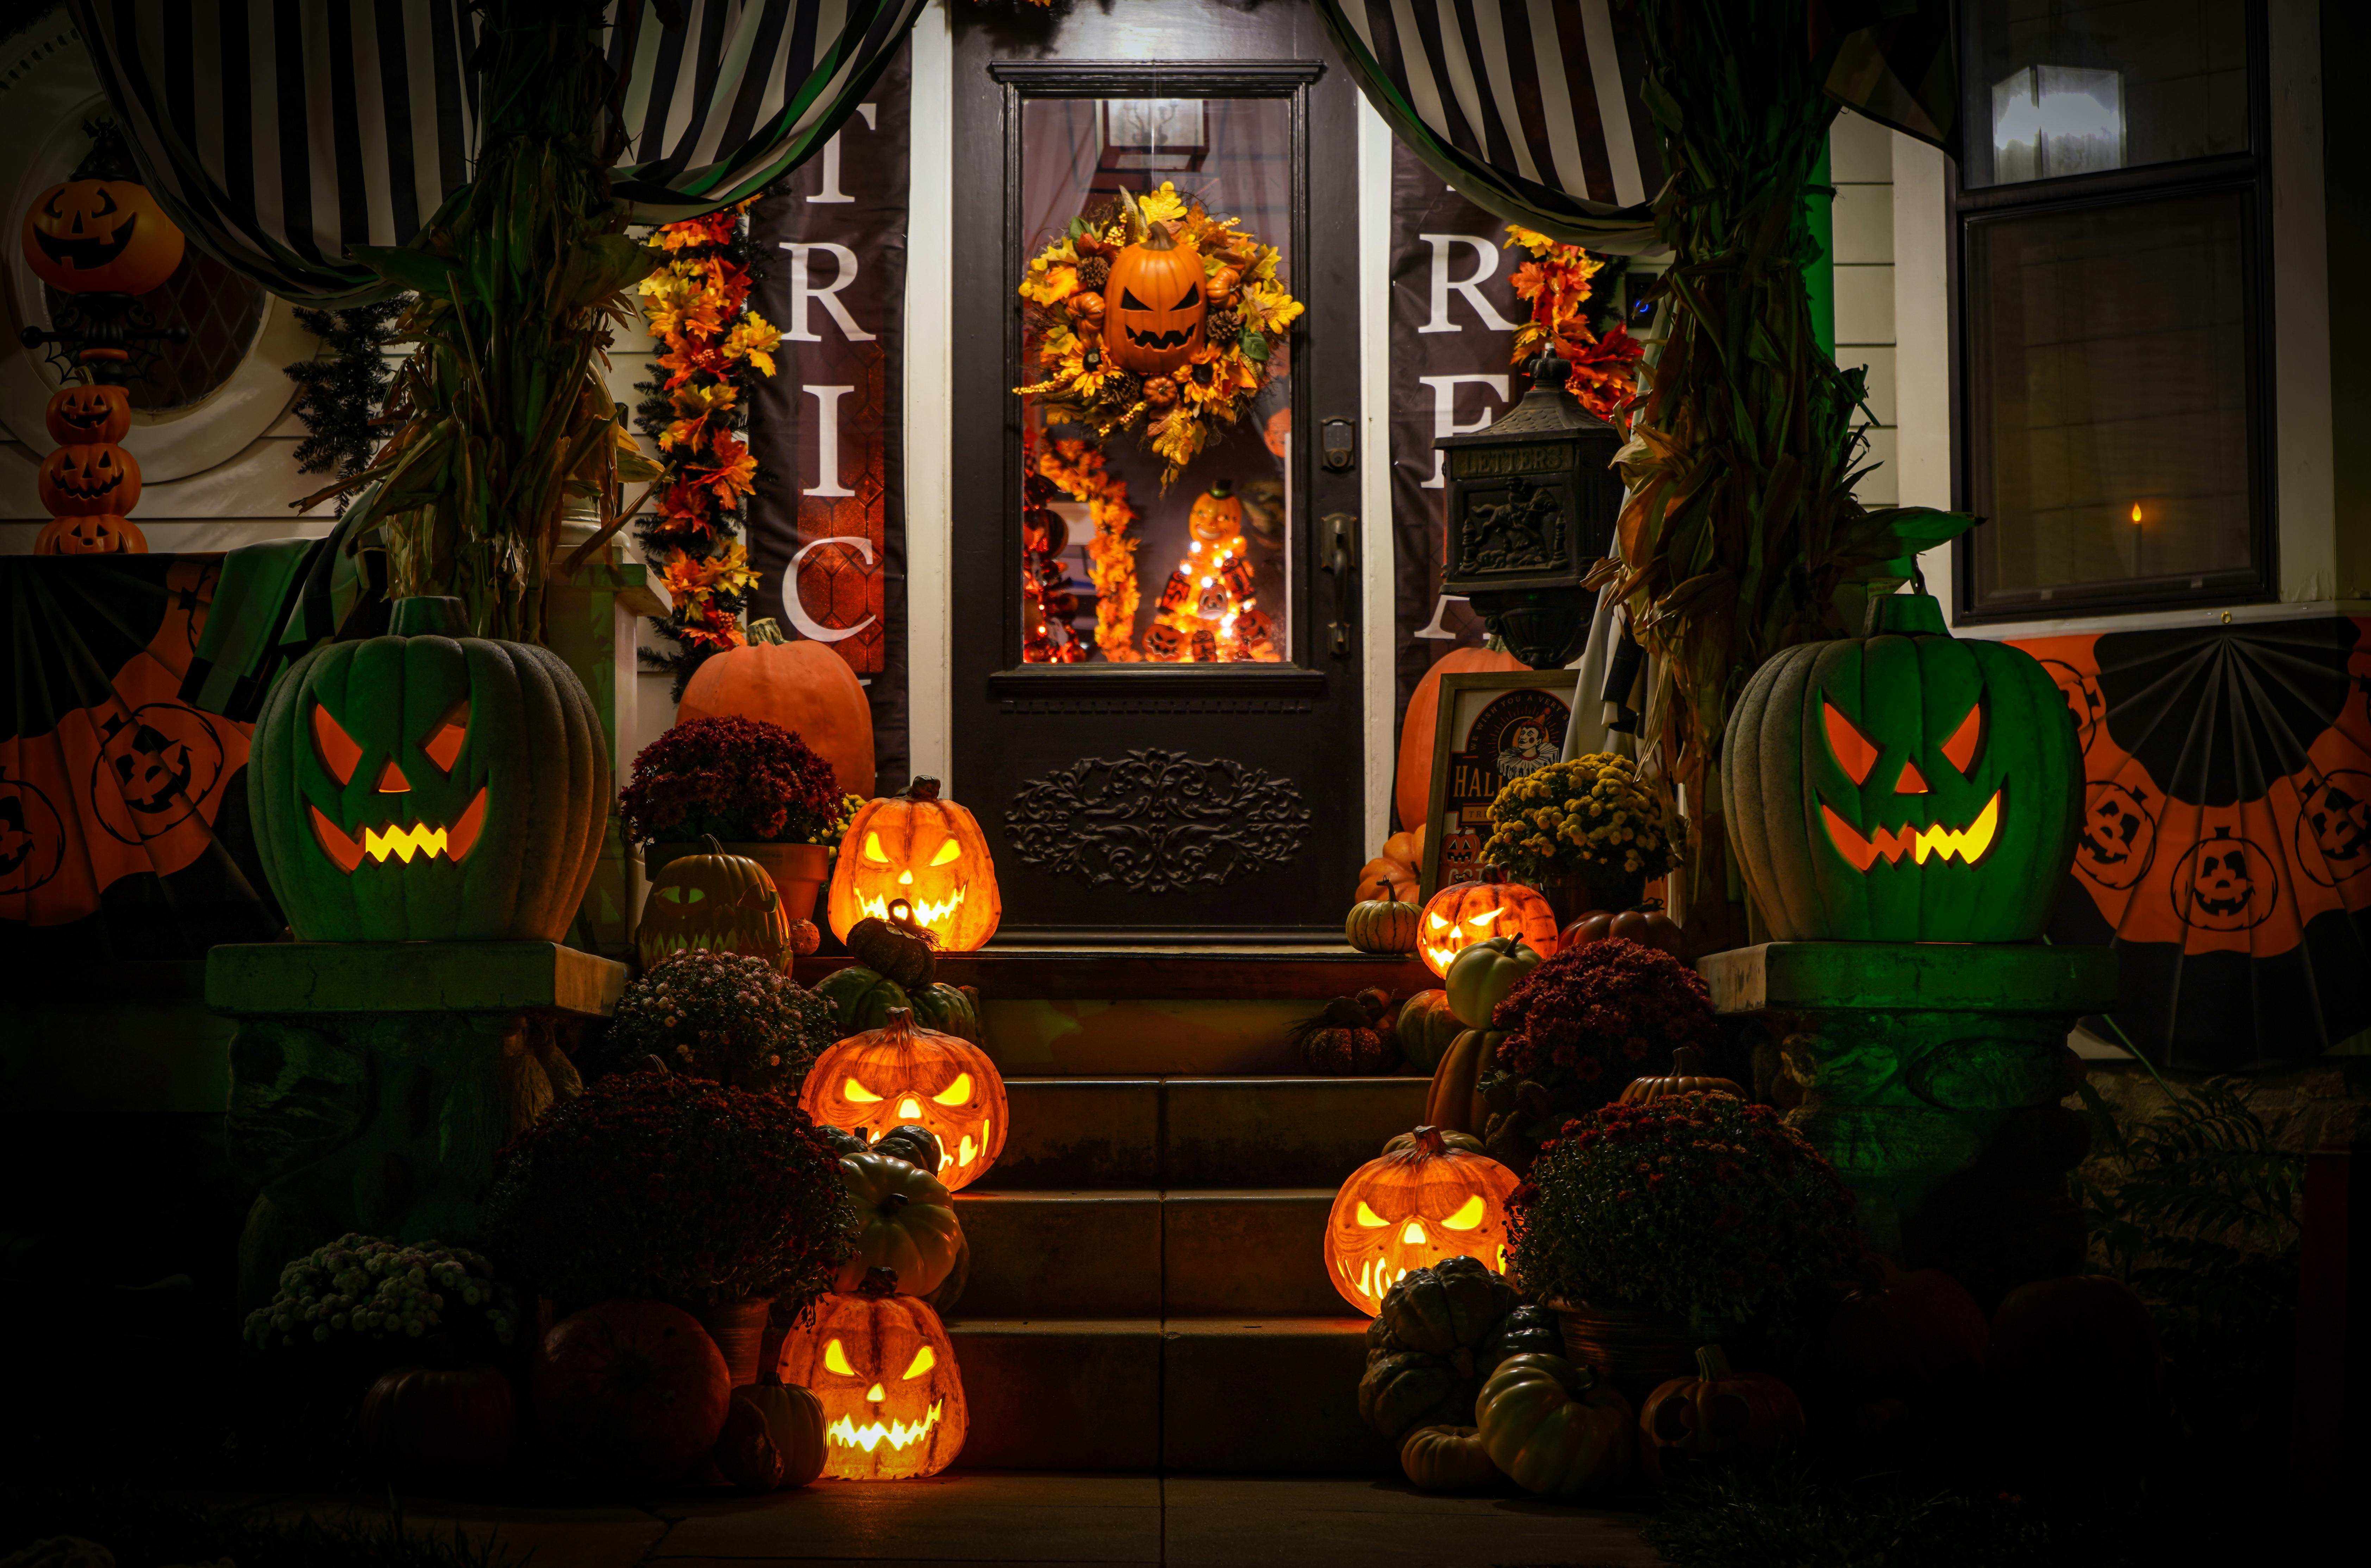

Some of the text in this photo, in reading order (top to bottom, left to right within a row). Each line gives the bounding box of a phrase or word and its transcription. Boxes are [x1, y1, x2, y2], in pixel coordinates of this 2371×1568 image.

[779, 103, 878, 686] TRIC
[1465, 445, 1563, 474] LETTERS
[1470, 736, 1478, 751] WE
[1476, 707, 1498, 730] WISH
[1500, 696, 1521, 707] YOU
[1539, 696, 1562, 712] VERY
